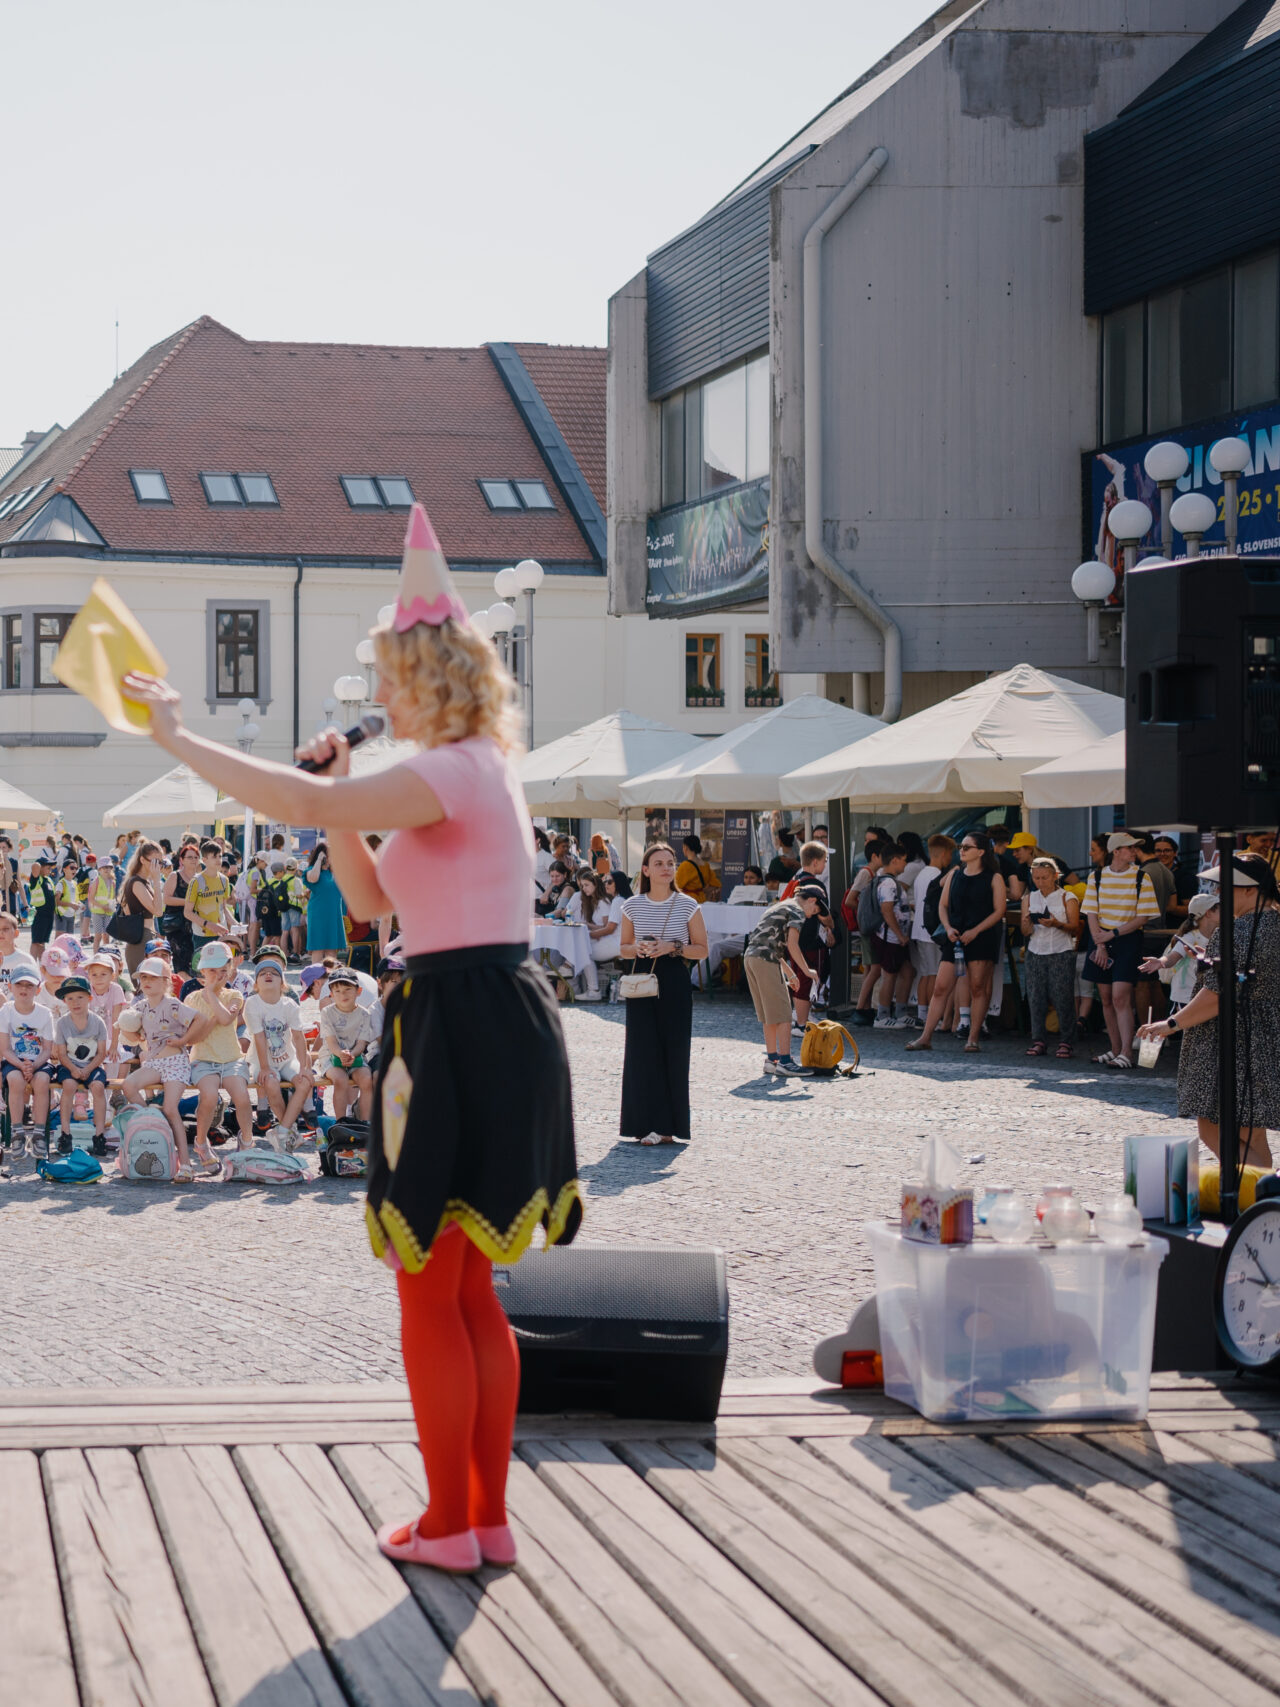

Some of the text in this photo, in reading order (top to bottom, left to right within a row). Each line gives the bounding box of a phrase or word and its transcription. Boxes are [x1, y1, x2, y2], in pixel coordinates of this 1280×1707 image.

[1217, 488, 1262, 521] 225
[1243, 537, 1280, 553] SLOVENS
[1263, 1229, 1274, 1244] 11
[1238, 1299, 1245, 1312] 8
[1246, 1321, 1253, 1334] 7
